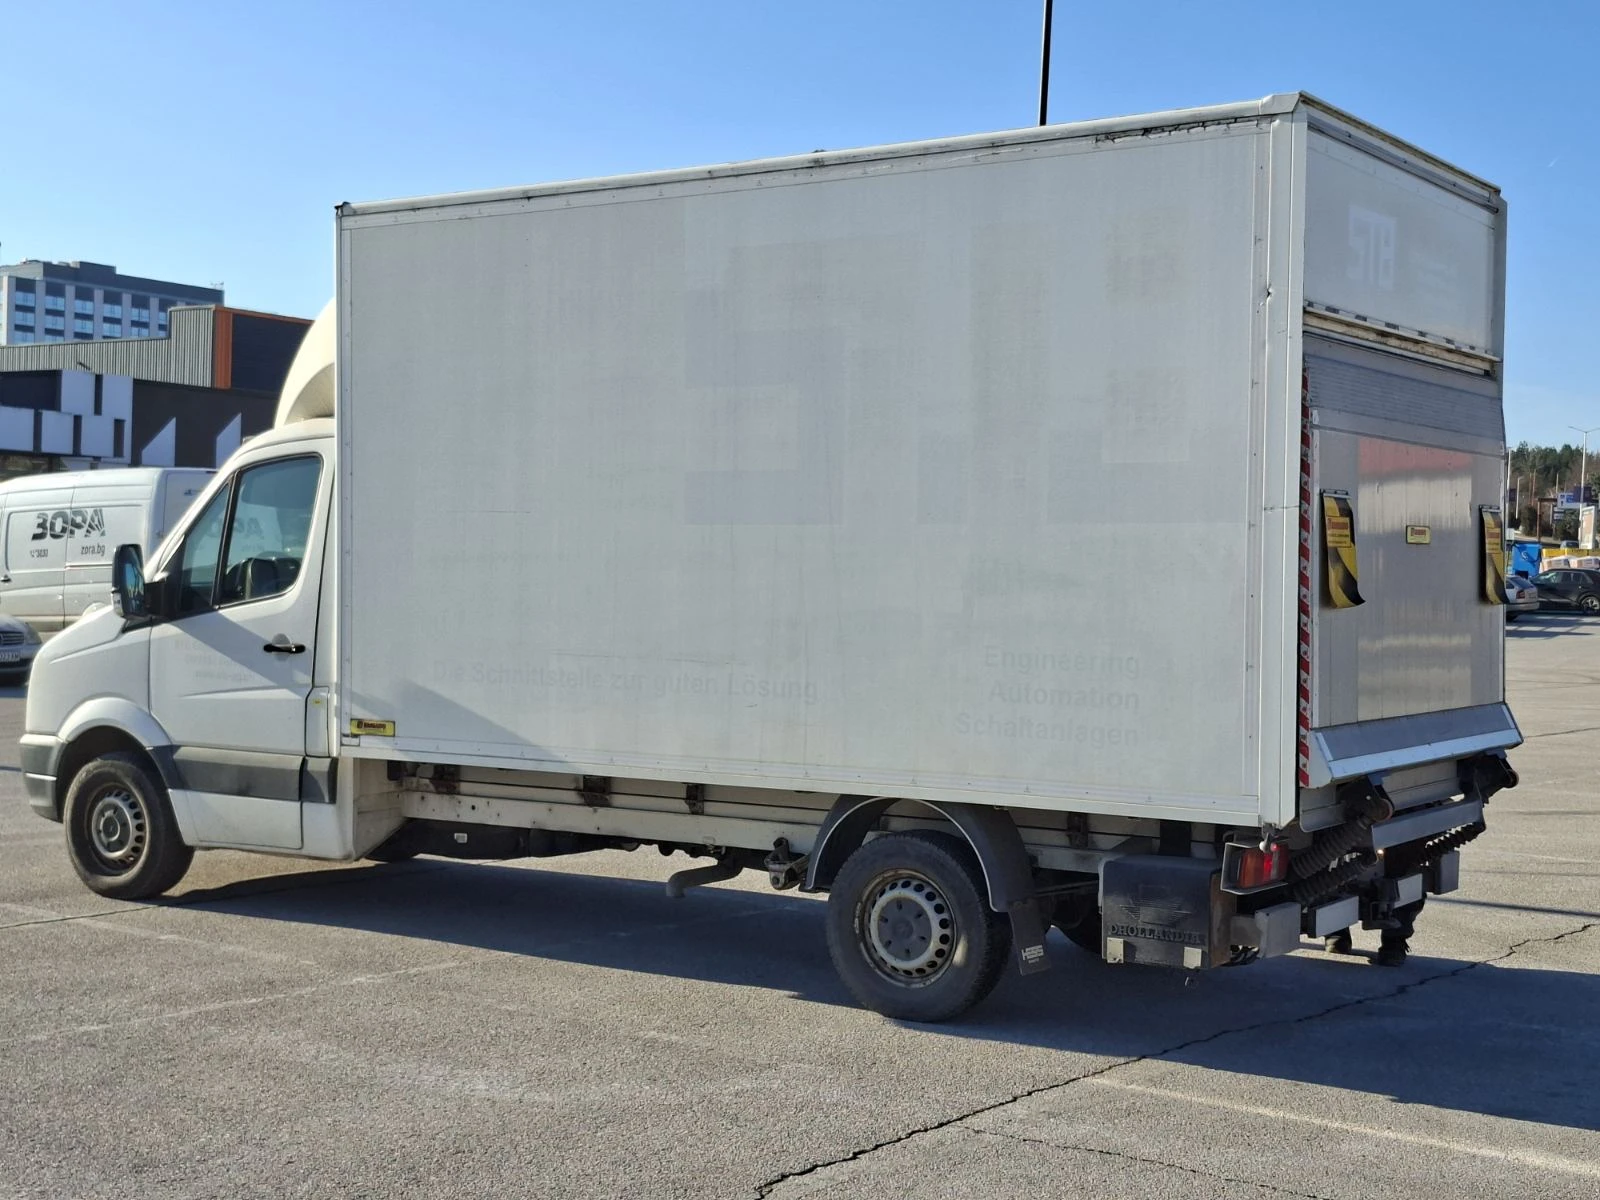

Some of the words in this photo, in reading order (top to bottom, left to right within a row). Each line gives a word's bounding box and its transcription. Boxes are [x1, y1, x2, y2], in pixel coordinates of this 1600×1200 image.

[80, 543, 106, 558] zora.bg
[984, 645, 1140, 681] Engineering
[472, 662, 602, 691] Schnittstelle
[610, 672, 647, 693] zur
[654, 671, 719, 700] guten
[728, 672, 818, 706] Lösung
[988, 680, 1140, 711] Automation
[954, 712, 1139, 749] Schaltanlagen
